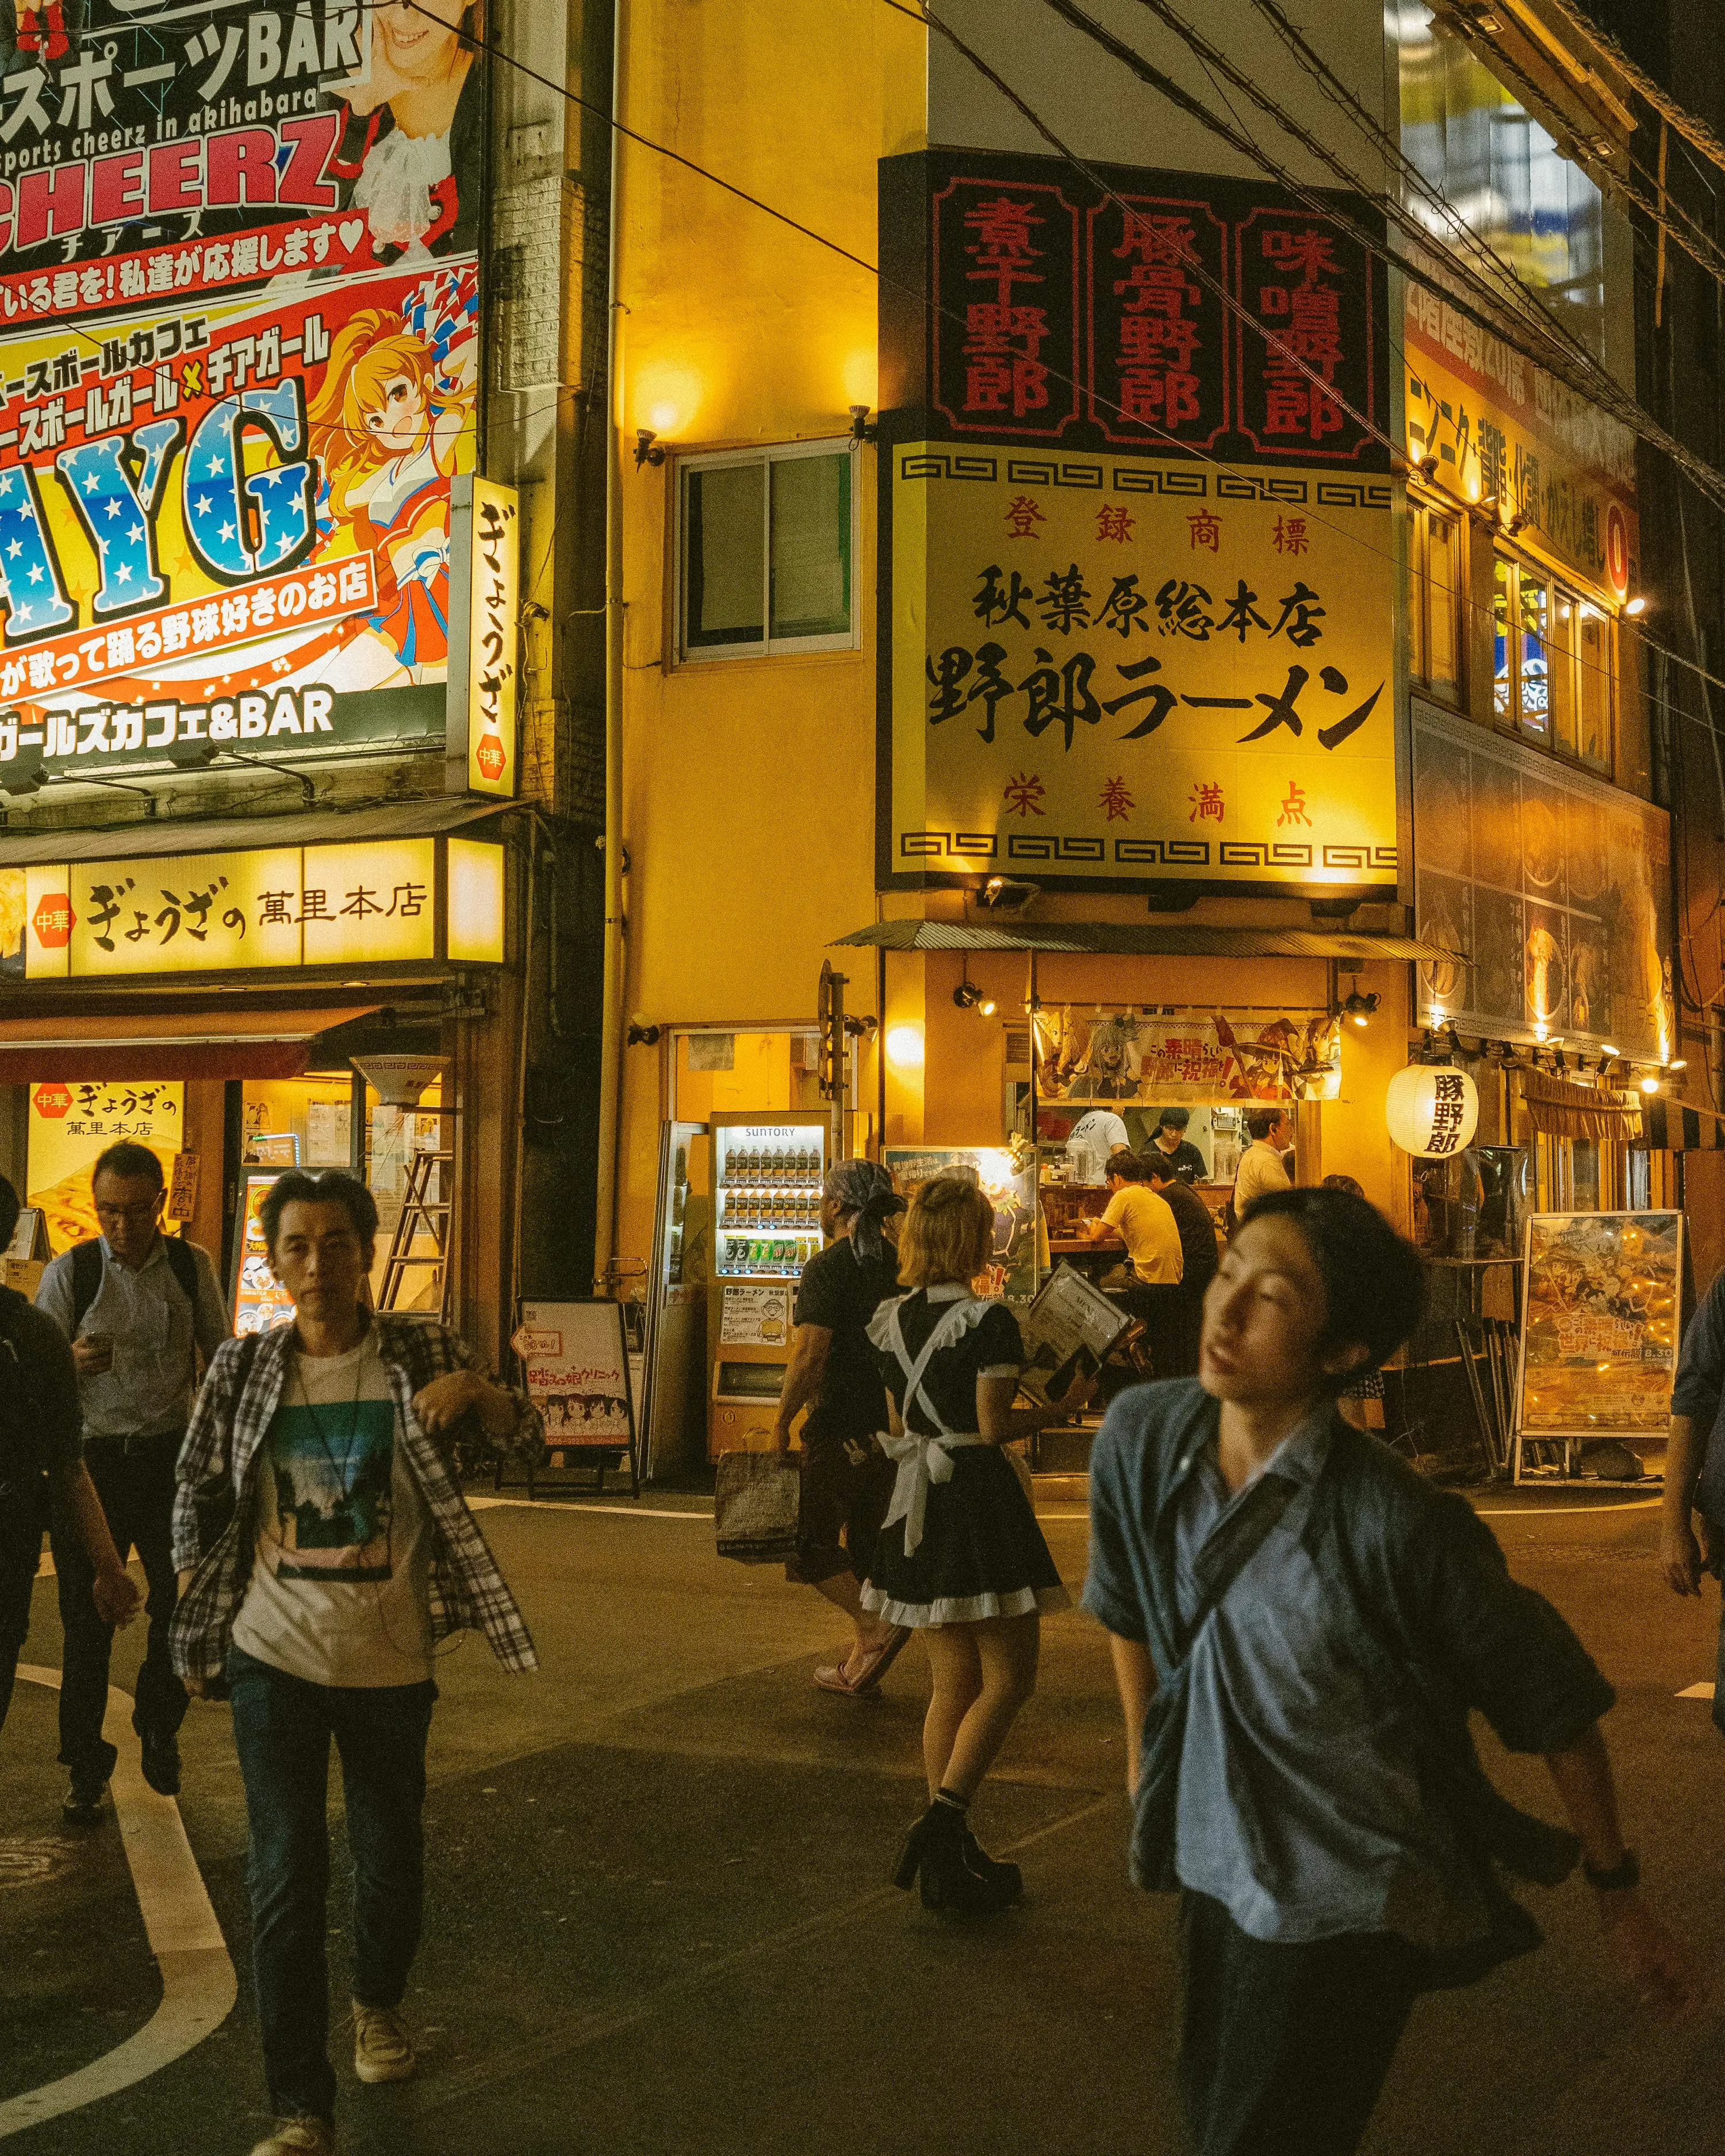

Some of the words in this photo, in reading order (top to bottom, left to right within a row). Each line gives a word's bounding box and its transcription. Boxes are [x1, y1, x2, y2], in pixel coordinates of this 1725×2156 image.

[0, 1, 361, 143] スポーツBAR
[0, 139, 61, 177] ports
[72, 117, 145, 158] cheerz
[157, 113, 177, 138] in
[190, 89, 317, 133] akihabara
[0, 111, 340, 253] HEERZ
[0, 226, 340, 317] いる君を!私達が応援します
[60, 209, 204, 263] チアーズ
[961, 197, 1049, 417] 煮干野郎
[1113, 212, 1203, 429] 豚骨野郎
[1260, 229, 1346, 440] 味噌野郎
[0, 316, 209, 407] ースボールカフェ
[1003, 495, 1310, 554] 登録商標
[1, 562, 367, 696] が歌って踊る野球好きのお店
[478, 502, 516, 724] ぎょうざ
[972, 563, 1327, 648] 秋葉原総本店
[925, 641, 1385, 752] 野郎ラーメン
[479, 747, 503, 769] 中華
[1003, 772, 1312, 827] 栄養満点
[36, 909, 70, 933] 中華
[37, 1092, 68, 1108] 中華
[66, 1122, 154, 1136] 萬里本店
[76, 1083, 177, 1117] ぎょうざの
[746, 1128, 795, 1137] SUNTORY
[1424, 1075, 1465, 1154] 豚野郎
